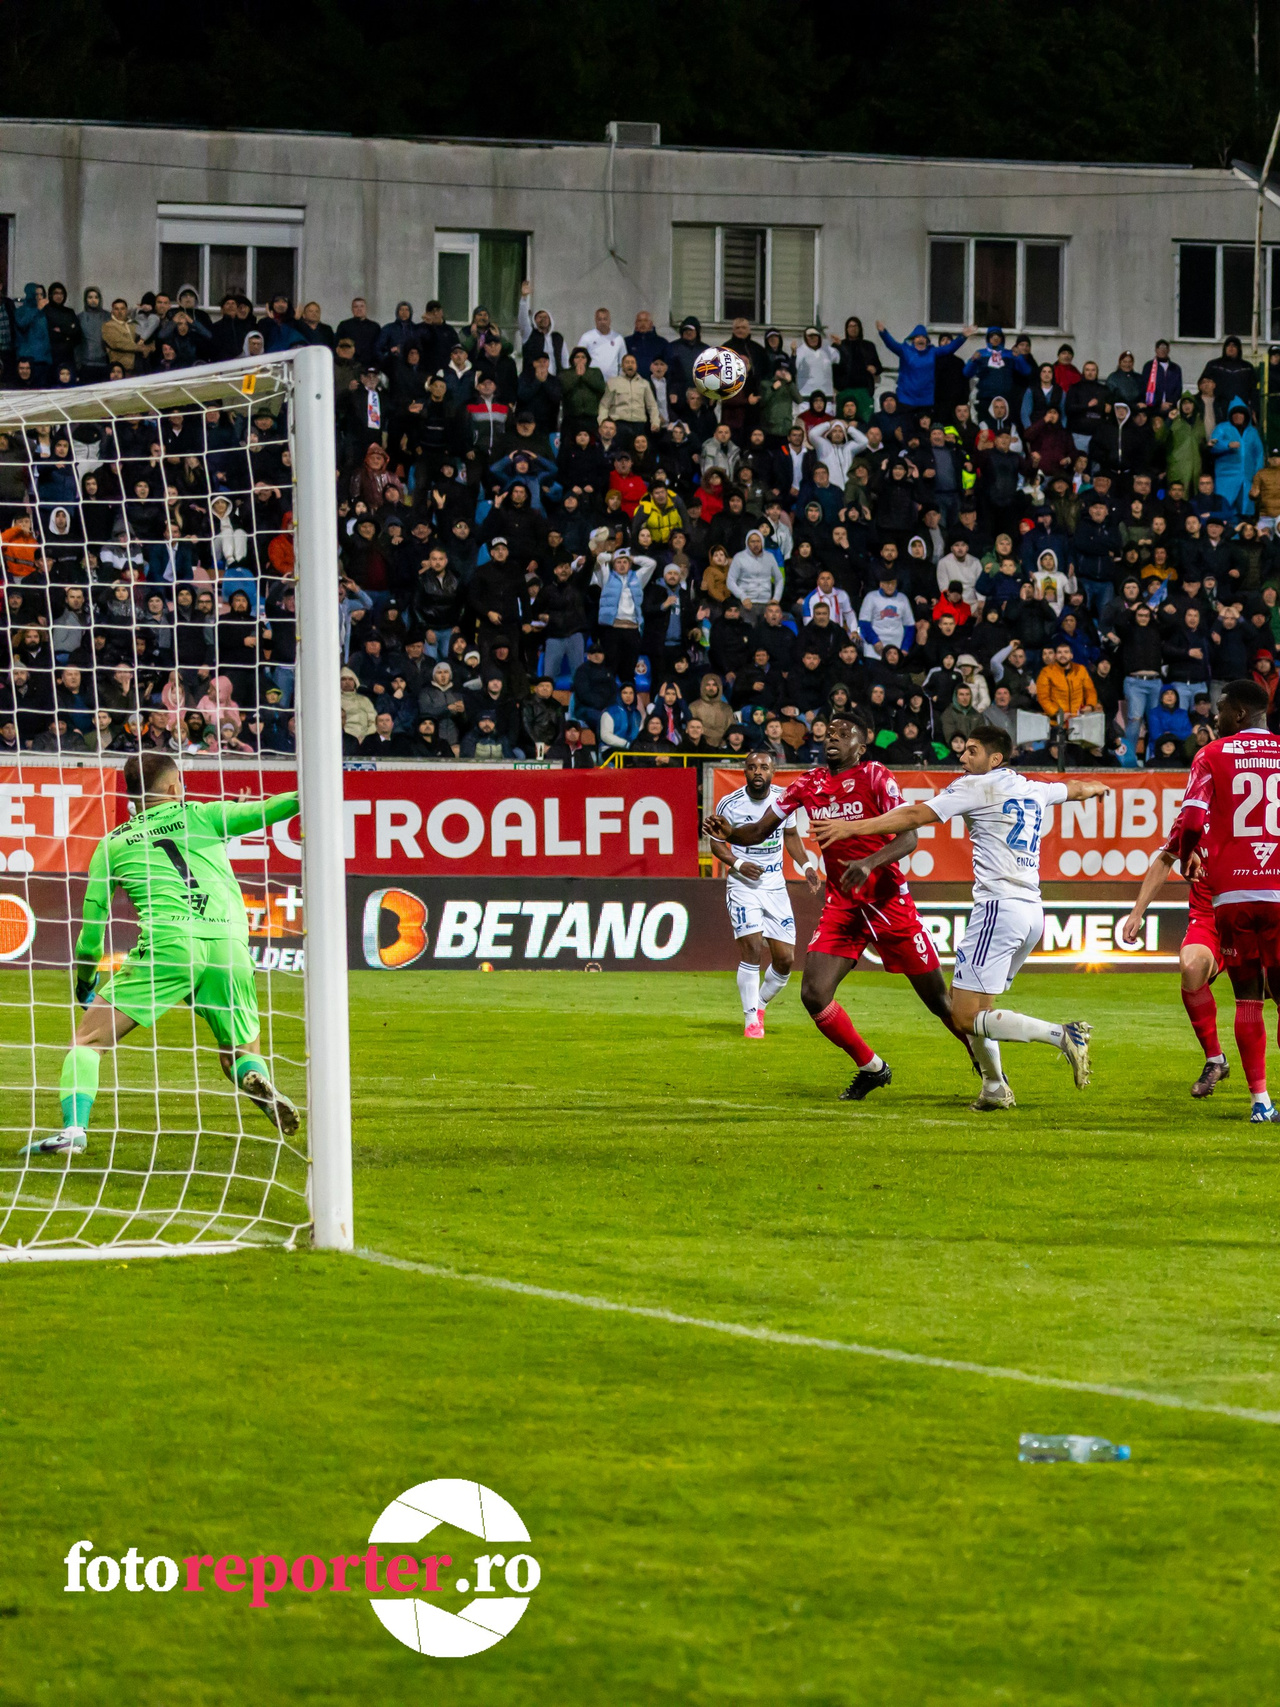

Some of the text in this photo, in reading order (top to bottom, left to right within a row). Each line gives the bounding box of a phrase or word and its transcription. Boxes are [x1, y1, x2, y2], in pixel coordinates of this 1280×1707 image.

[723, 353, 733, 380] SELECT
[1003, 799, 1041, 852] 27
[152, 838, 200, 889] 1
[434, 900, 688, 960] BETANO
[736, 906, 746, 924] 11
[1043, 915, 1158, 951] MECI
[913, 932, 927, 954] 8
